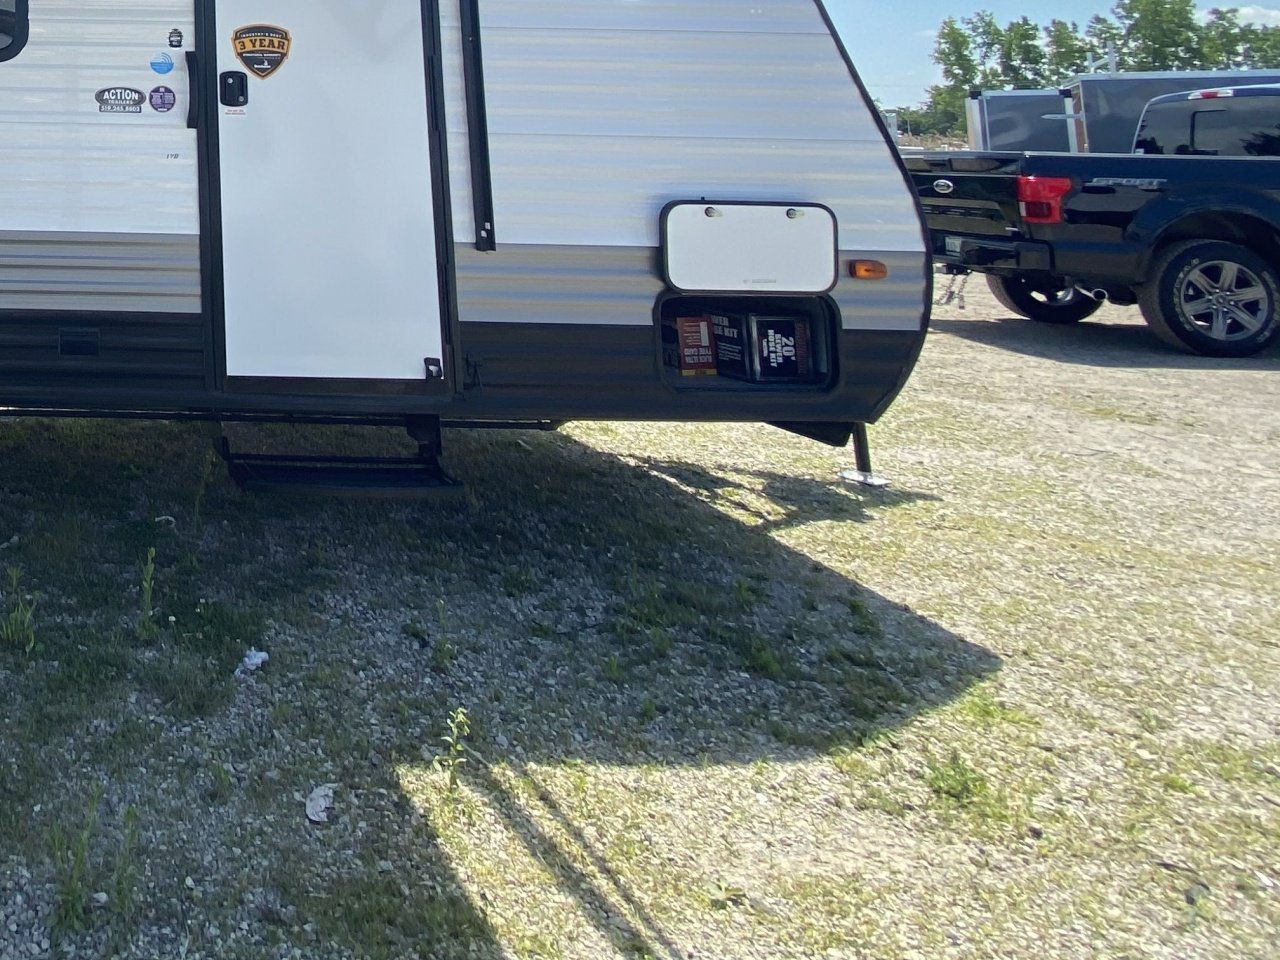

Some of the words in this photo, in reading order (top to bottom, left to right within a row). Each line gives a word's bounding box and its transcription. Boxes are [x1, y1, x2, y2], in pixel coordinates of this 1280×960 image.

[238, 40, 246, 51] 3
[249, 38, 286, 51] YEAR
[103, 89, 139, 100] ACTION
[1084, 177, 1168, 187] SPORT
[767, 329, 776, 352] HOSE
[775, 333, 783, 363] SEWER
[769, 352, 778, 368] KIT
